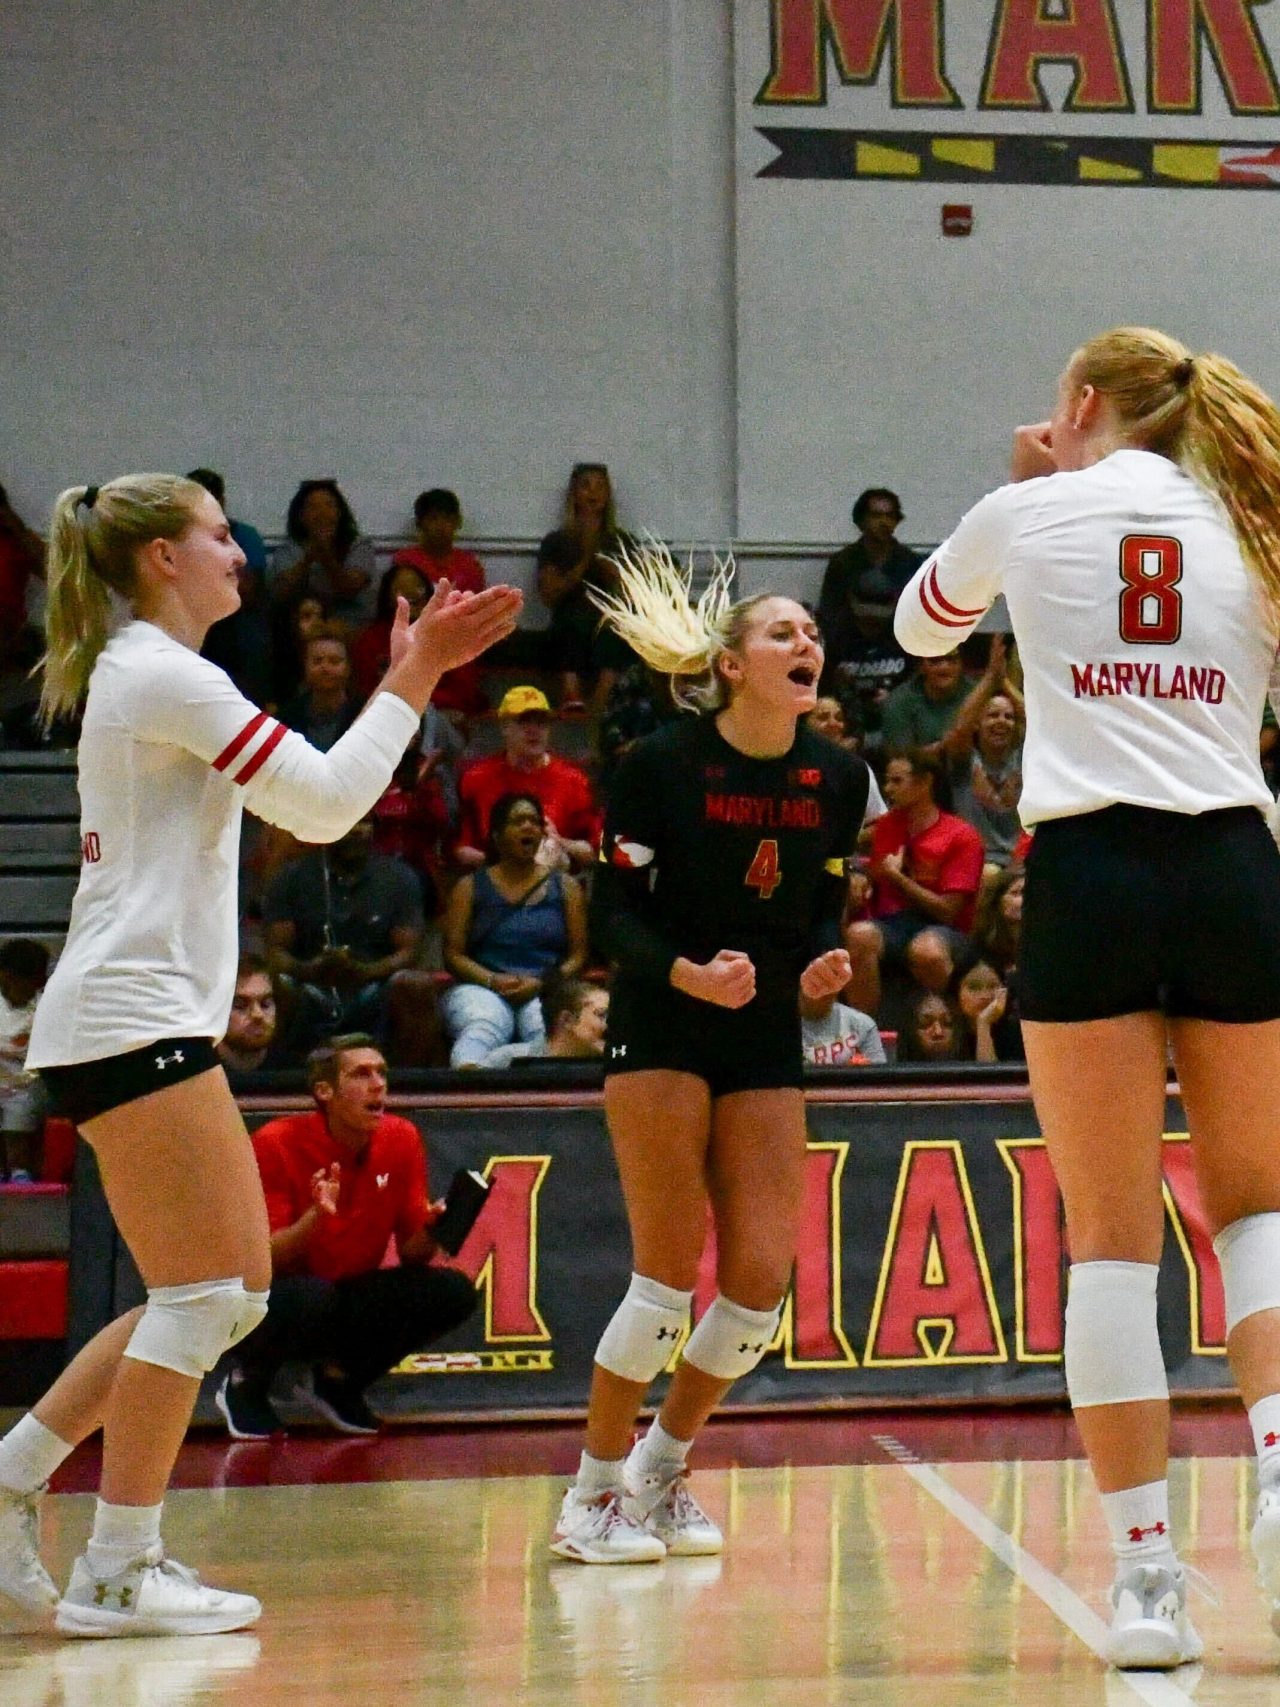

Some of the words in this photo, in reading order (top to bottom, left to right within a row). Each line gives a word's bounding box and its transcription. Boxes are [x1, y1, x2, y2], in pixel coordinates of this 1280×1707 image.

[1118, 533, 1184, 646] 8
[1070, 662, 1226, 705] MARYLAND
[705, 793, 821, 829] MARYLAND
[744, 839, 782, 899] 4
